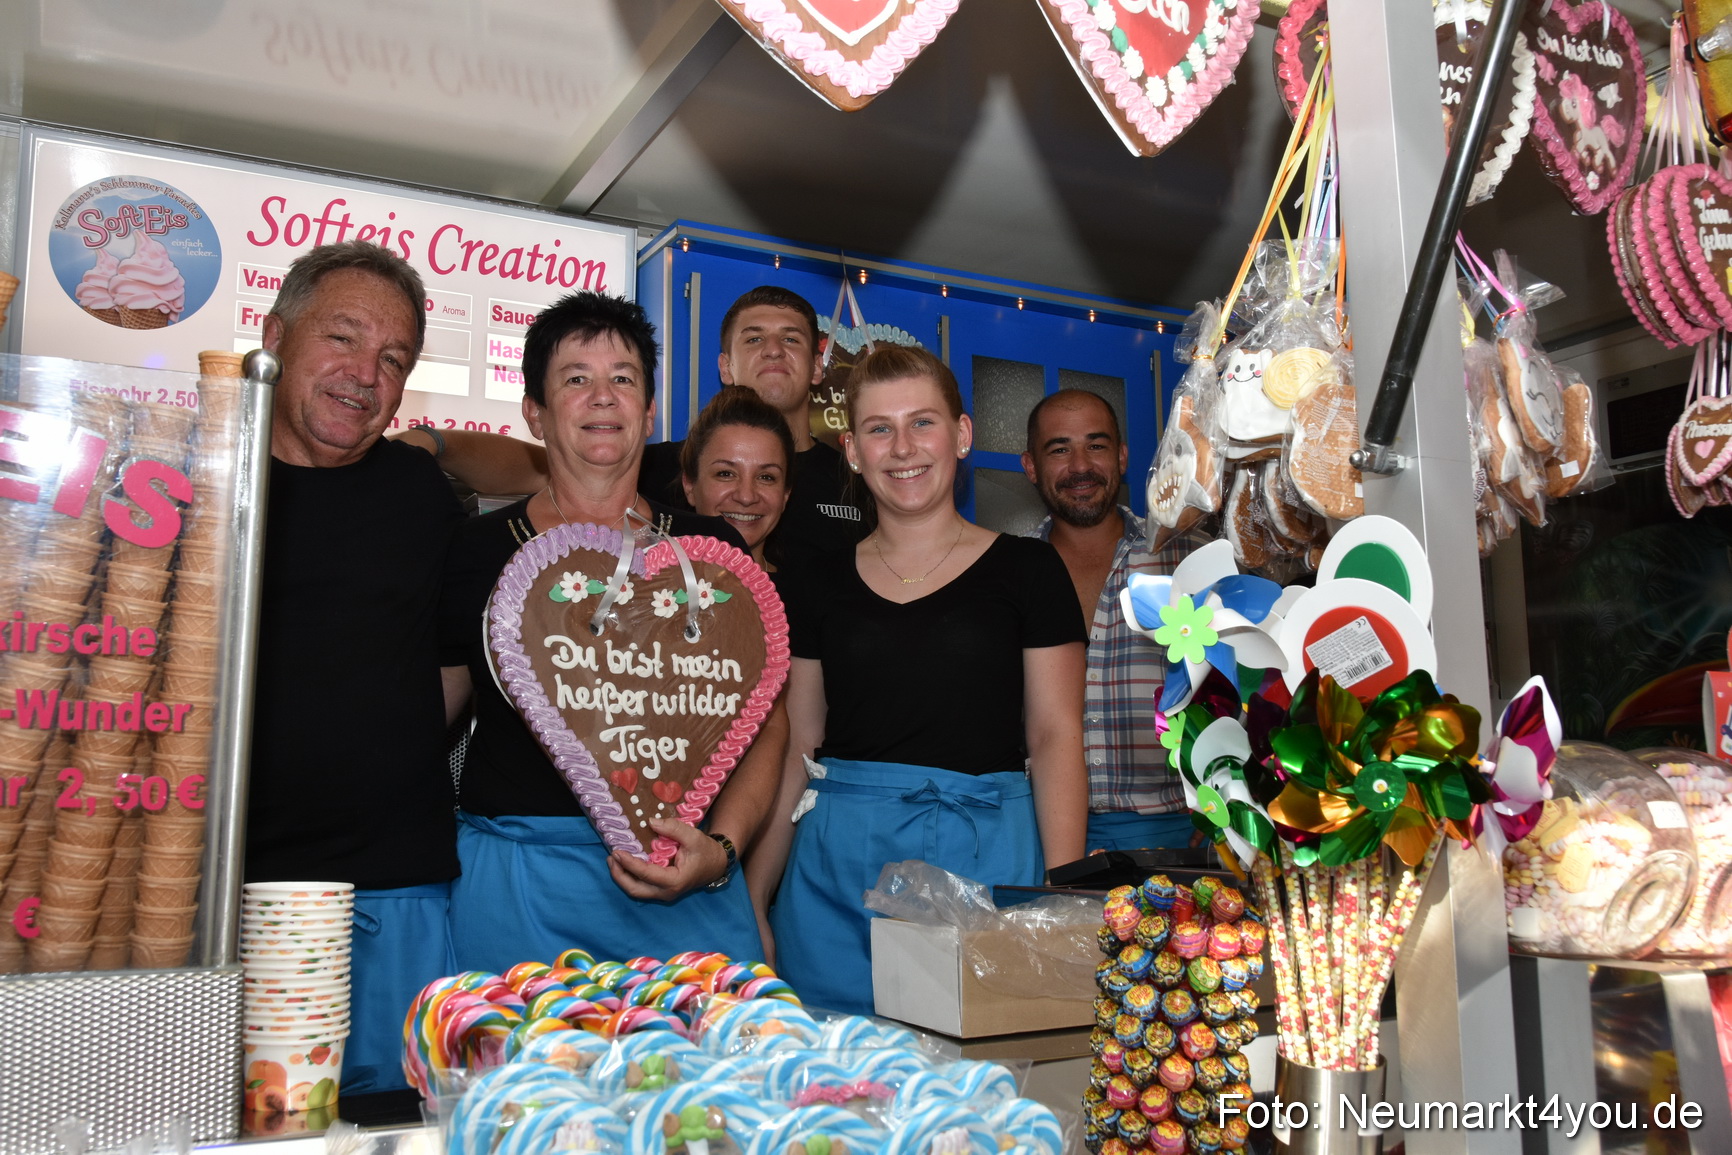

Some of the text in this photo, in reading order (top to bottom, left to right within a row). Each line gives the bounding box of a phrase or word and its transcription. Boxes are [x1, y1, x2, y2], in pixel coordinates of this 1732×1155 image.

[171, 238, 204, 249] einfach
[246, 195, 416, 261] Softeis
[242, 268, 287, 291] Van
[427, 223, 608, 293] Creation
[442, 305, 466, 317] Aroma
[156, 388, 198, 409] 2.50
[543, 634, 744, 682] Du bist mein
[554, 674, 742, 725] heißer wilder
[599, 724, 691, 780] Tiger
